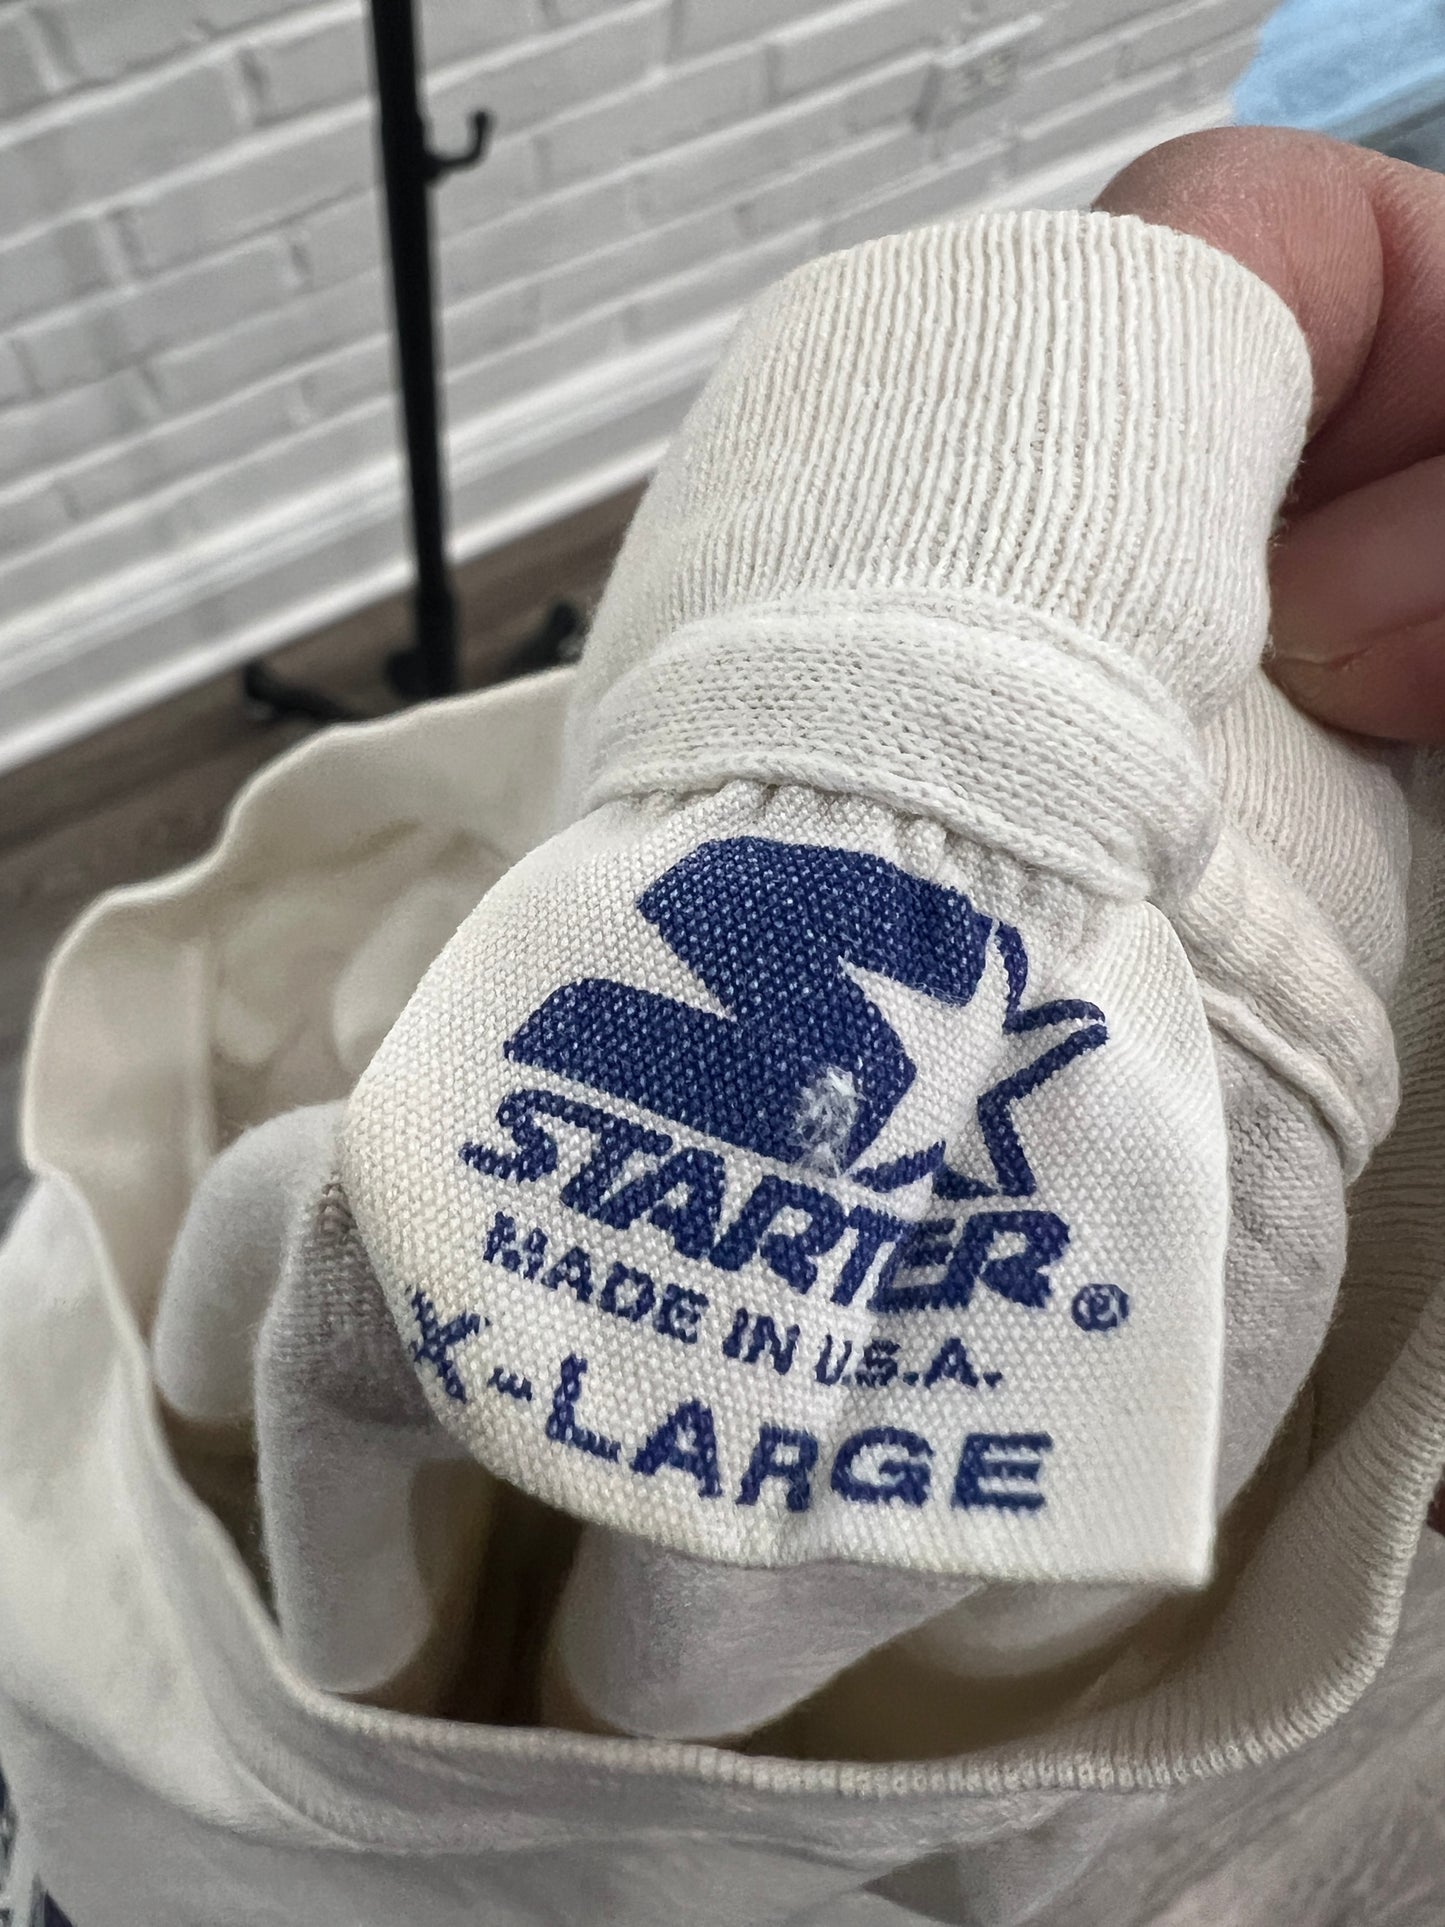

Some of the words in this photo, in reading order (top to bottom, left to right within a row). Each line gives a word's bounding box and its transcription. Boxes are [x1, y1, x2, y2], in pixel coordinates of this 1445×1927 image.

[458, 1088, 1071, 1314] STARTER
[482, 1210, 710, 1344] MADE
[722, 1307, 801, 1375] IN
[814, 1334, 1004, 1389] U.S.A.
[405, 1284, 1055, 1513] X-LARGE
